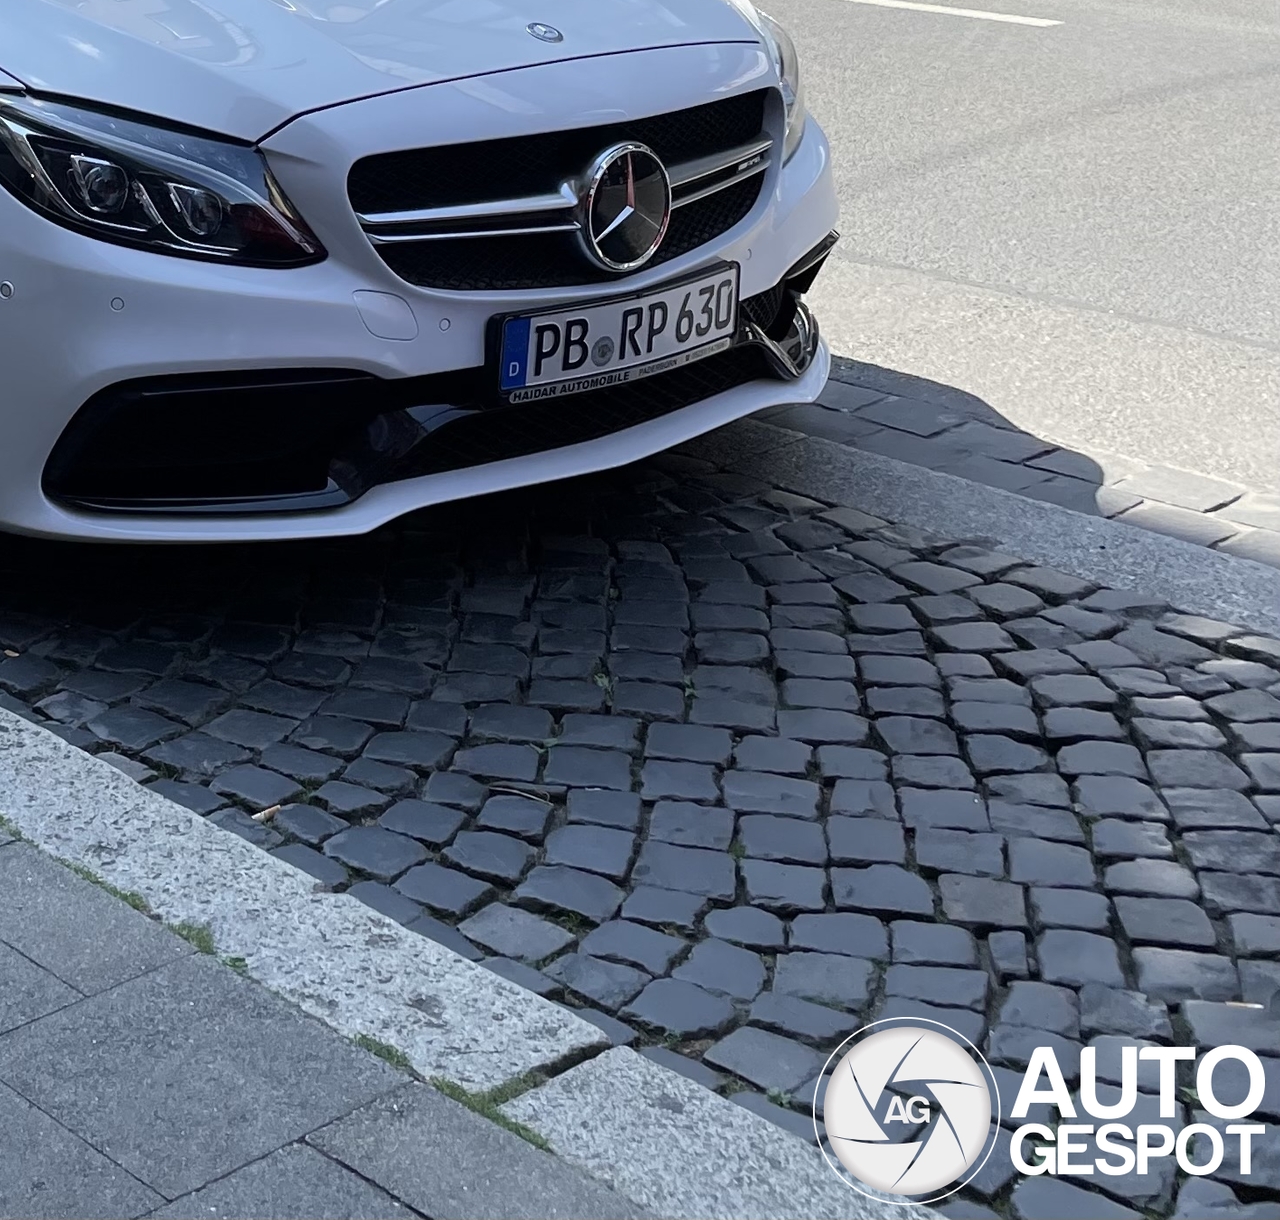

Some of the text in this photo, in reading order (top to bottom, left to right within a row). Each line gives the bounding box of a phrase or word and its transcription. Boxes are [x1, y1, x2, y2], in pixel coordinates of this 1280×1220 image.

[533, 279, 733, 377] PB RP 630
[508, 361, 520, 377] D
[512, 386, 557, 403] HAIDAR
[559, 371, 630, 394] AUTOMOBILE
